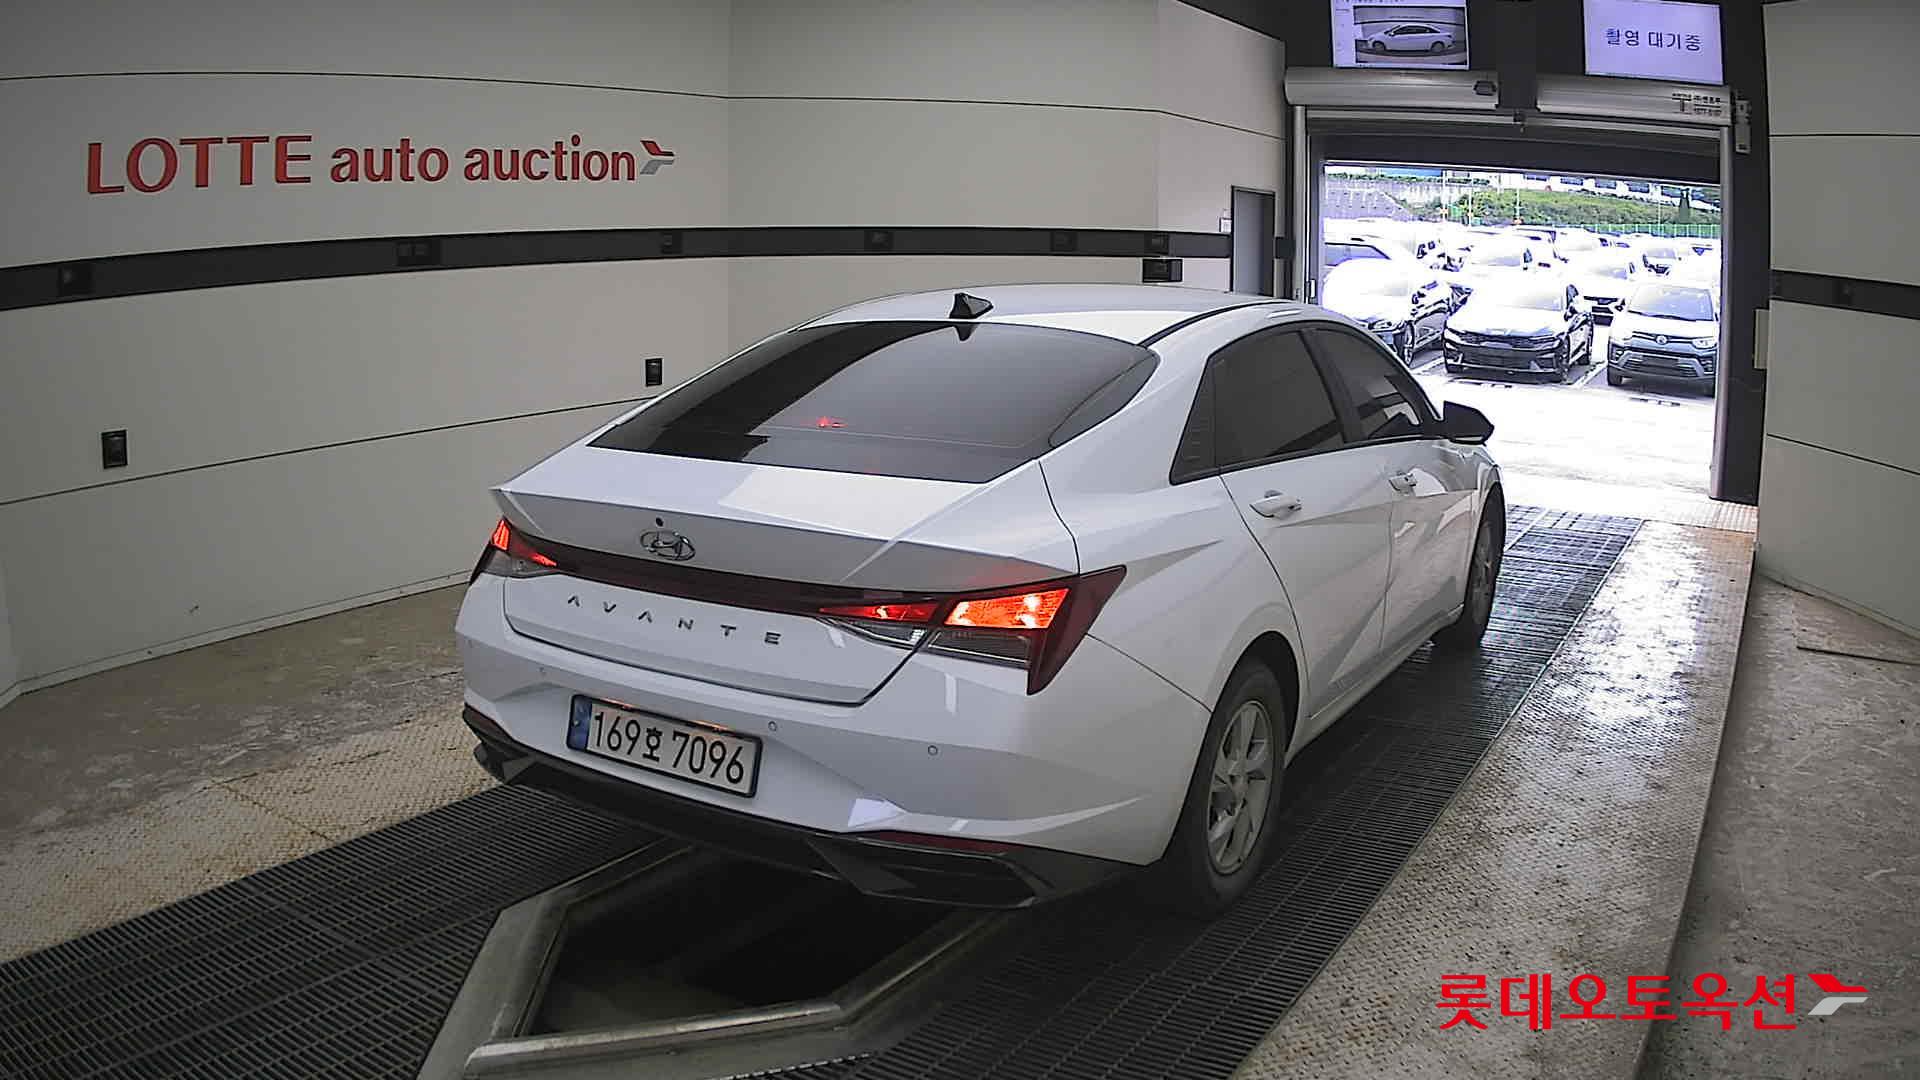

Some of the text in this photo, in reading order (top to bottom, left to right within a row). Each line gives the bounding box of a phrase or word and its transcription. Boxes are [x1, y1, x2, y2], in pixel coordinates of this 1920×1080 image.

[1648, 31, 1702, 52] 대기중
[86, 134, 636, 195] LOTTE auto auction
[567, 594, 782, 645] AVANTE
